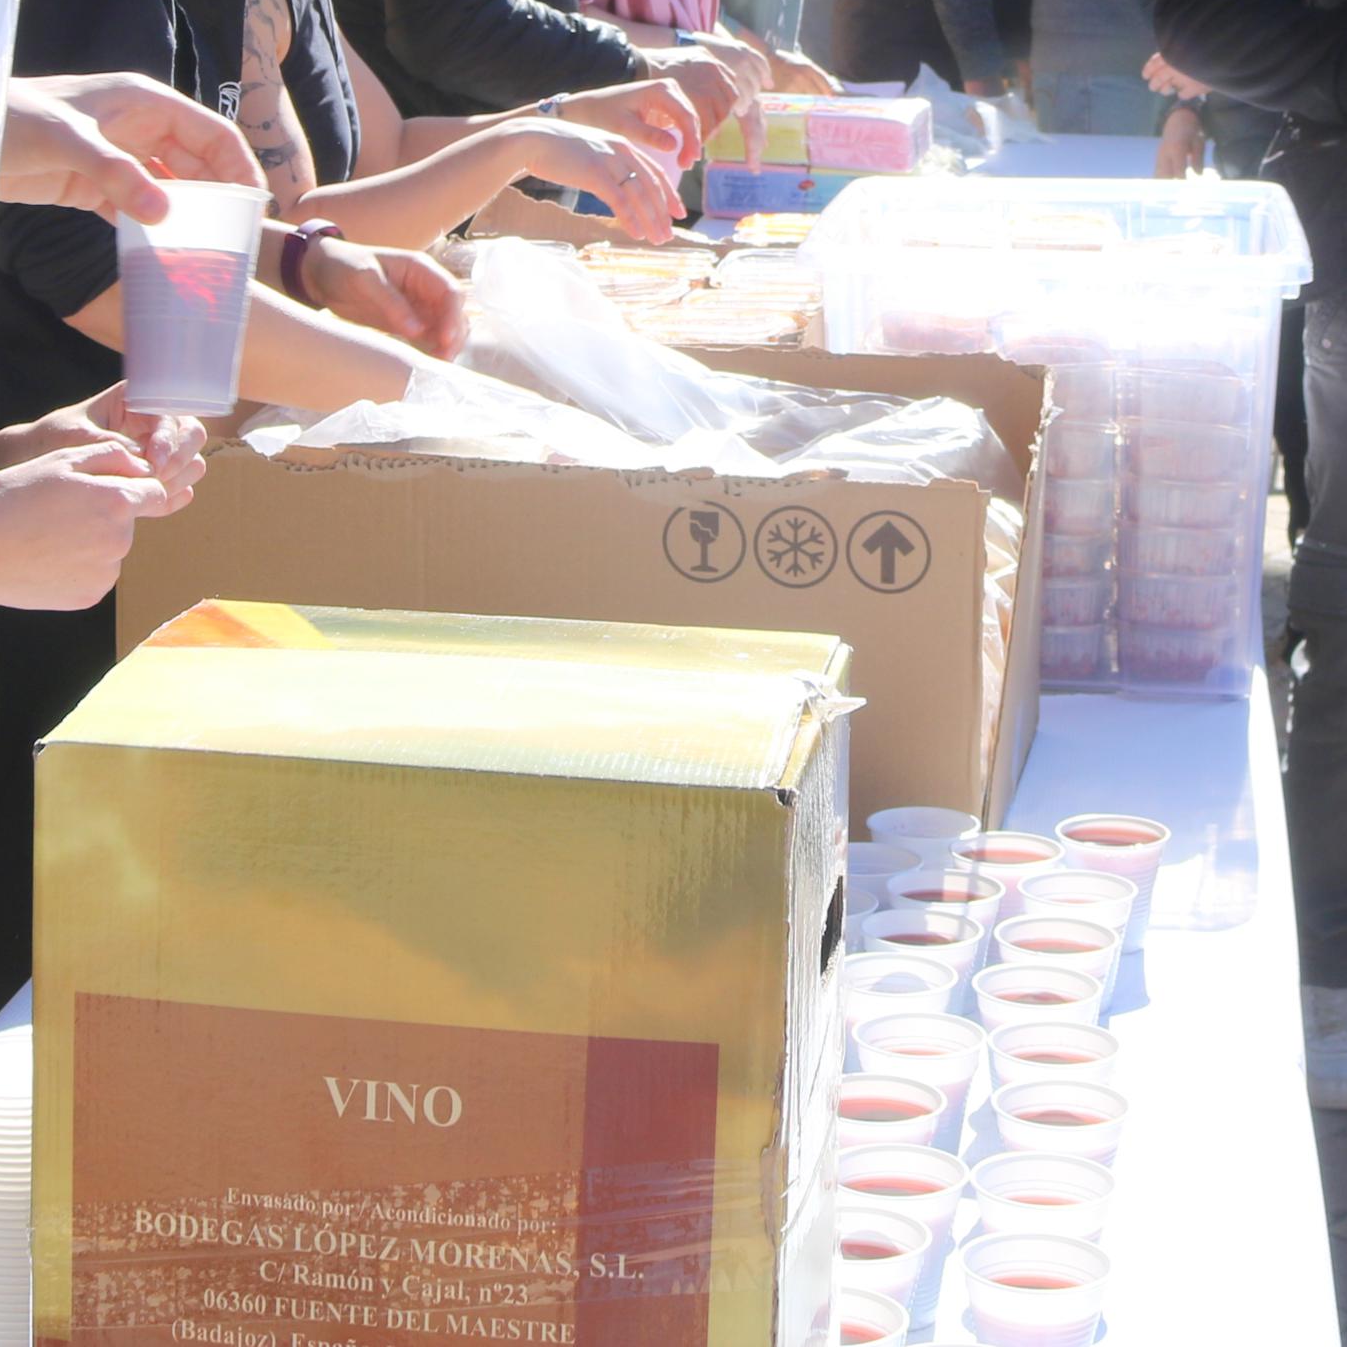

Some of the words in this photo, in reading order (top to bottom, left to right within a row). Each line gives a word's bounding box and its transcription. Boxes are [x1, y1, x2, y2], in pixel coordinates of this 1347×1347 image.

[322, 1075, 463, 1128] VINO
[226, 1186, 316, 1213] Envasado
[322, 1201, 354, 1219] por
[370, 1203, 511, 1230] Acondicionado
[517, 1218, 557, 1237] por:
[134, 1208, 284, 1250] BODEGAS
[293, 1223, 400, 1261] LÓPEZ
[410, 1238, 581, 1282] MORENAS,
[589, 1252, 645, 1279] S.L.
[259, 1260, 286, 1283] C/
[293, 1264, 374, 1293] Ramón
[381, 1277, 395, 1300] y
[402, 1275, 471, 1305] Cajal,
[479, 1283, 529, 1306] nº23
[171, 1319, 277, 1347] (Badajoz)
[203, 1287, 267, 1314] 06360
[274, 1297, 378, 1328] FUENTE
[386, 1307, 439, 1333] DEL
[445, 1314, 576, 1345] MAESTRE
